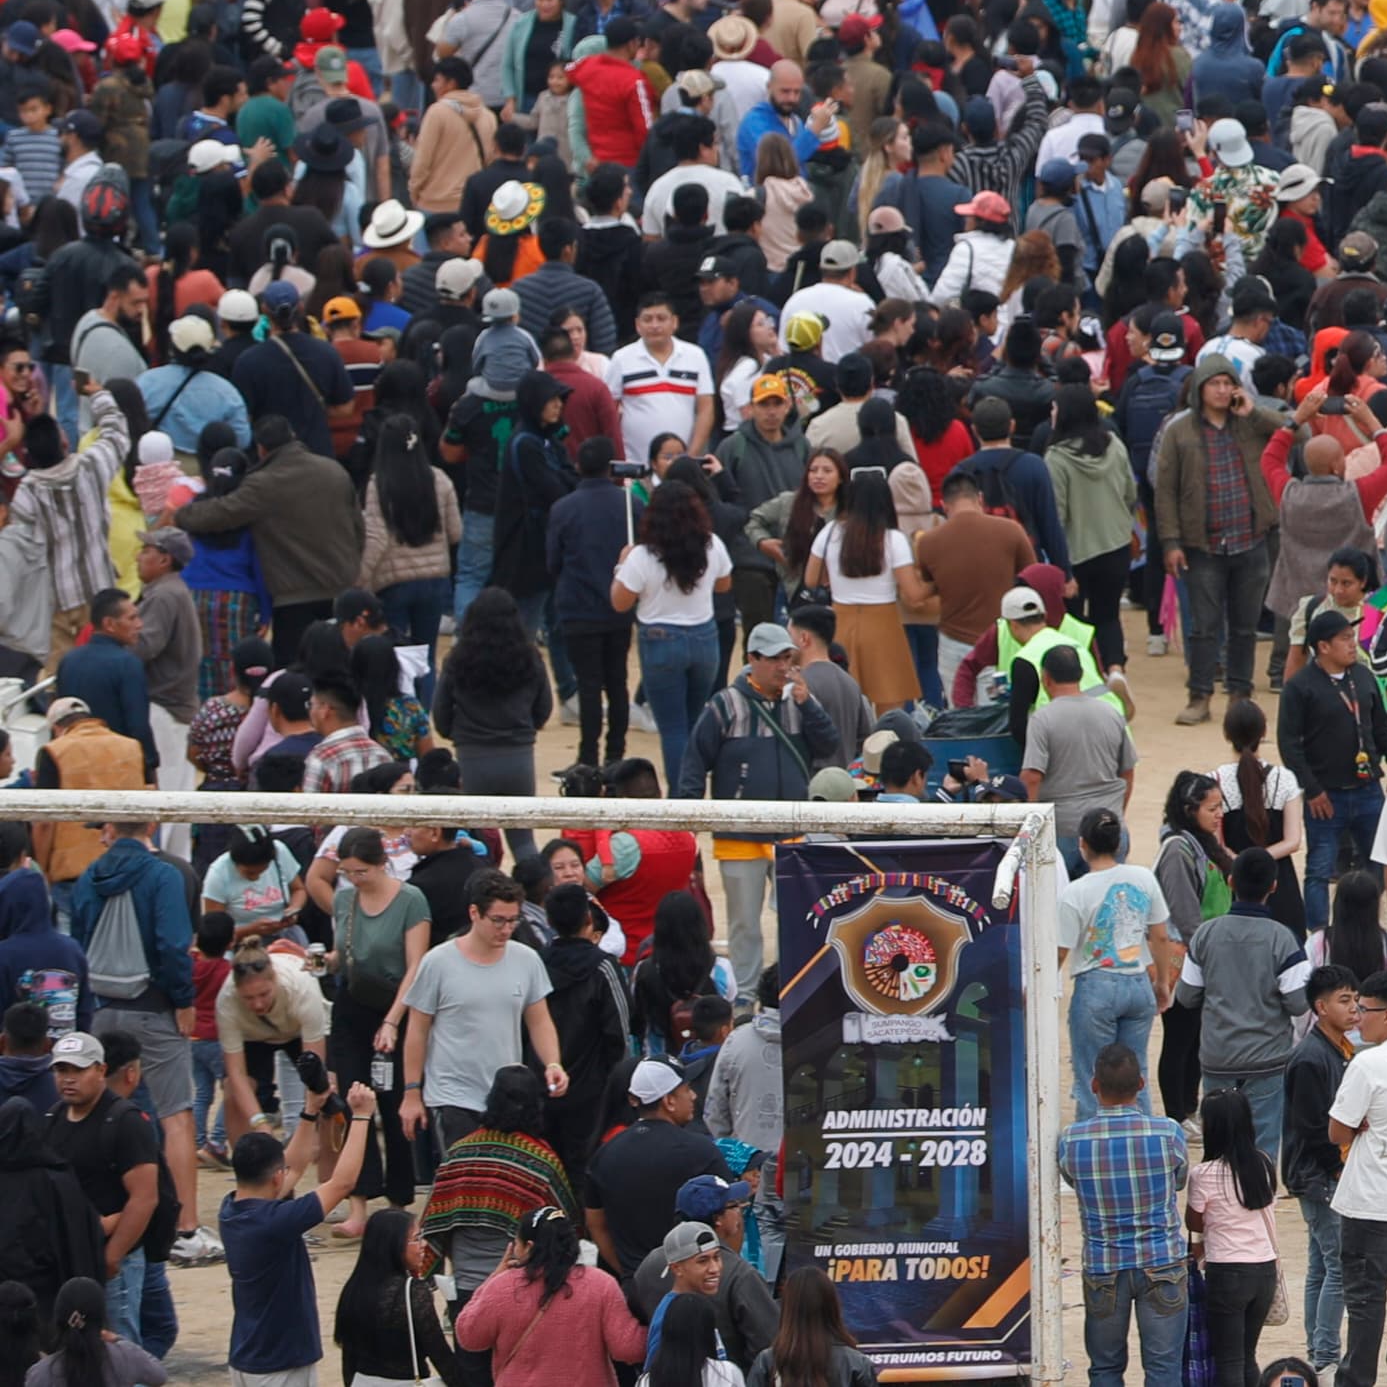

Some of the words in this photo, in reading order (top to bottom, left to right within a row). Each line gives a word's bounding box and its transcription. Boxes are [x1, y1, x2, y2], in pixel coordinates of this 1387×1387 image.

[871, 1019, 922, 1029] SUMPANGO
[867, 1027, 937, 1039] SACATEPÉQUEZ
[822, 1103, 987, 1130] ADMINISTRACIÓN
[824, 1141, 893, 1169] 2024
[919, 1139, 987, 1167] 2028
[814, 1245, 832, 1257] UN
[834, 1243, 894, 1257] GOBIERNO
[896, 1242, 959, 1255] MUNICIPAL
[905, 1255, 990, 1281] TODOS!
[868, 1352, 944, 1365] NSTRUIMOS
[946, 1349, 1002, 1362] FUTURO
